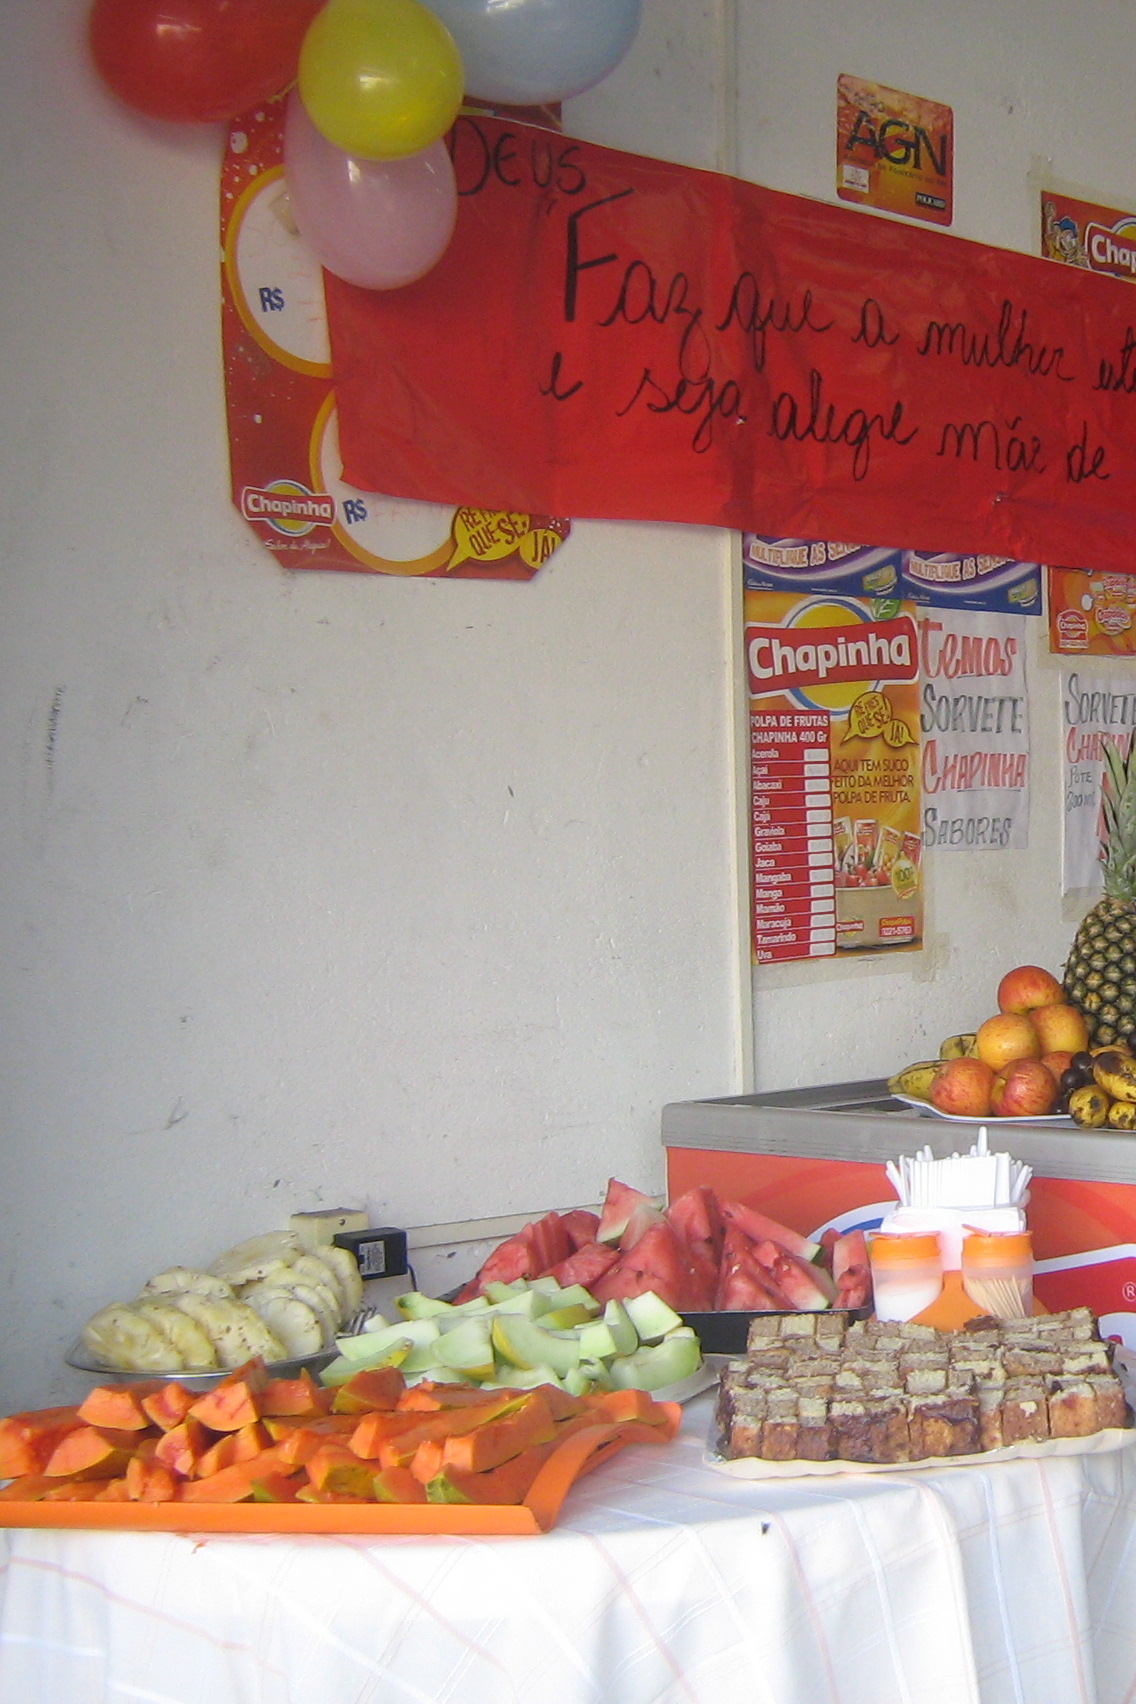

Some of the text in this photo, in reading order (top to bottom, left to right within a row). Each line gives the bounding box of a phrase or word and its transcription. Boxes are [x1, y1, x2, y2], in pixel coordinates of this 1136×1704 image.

[844, 110, 948, 176] AGN
[258, 286, 285, 313] R$
[564, 188, 711, 385] Faz
[717, 272, 834, 372] que
[852, 298, 899, 347] a
[917, 299, 1076, 381] mulher
[540, 352, 583, 401] e
[770, 369, 918, 481] alegre
[1067, 420, 1110, 482] de
[247, 493, 332, 519] Chapinha
[342, 497, 368, 525] R$
[749, 633, 912, 680] Chapinha
[750, 714, 829, 728] POLPA DE FRUTAS
[920, 682, 1024, 734] SORVETE
[751, 731, 798, 744] CHAPINHA
[799, 731, 815, 743] 400
[834, 758, 909, 772] AQUI TEM SUCO
[922, 739, 1028, 795] CHAPINHA
[831, 775, 914, 788] FEITO DA MELHOR
[833, 791, 862, 804] POLPA
[865, 791, 877, 803] DE
[923, 807, 1013, 847] SABORES
[757, 950, 772, 960] Uva
